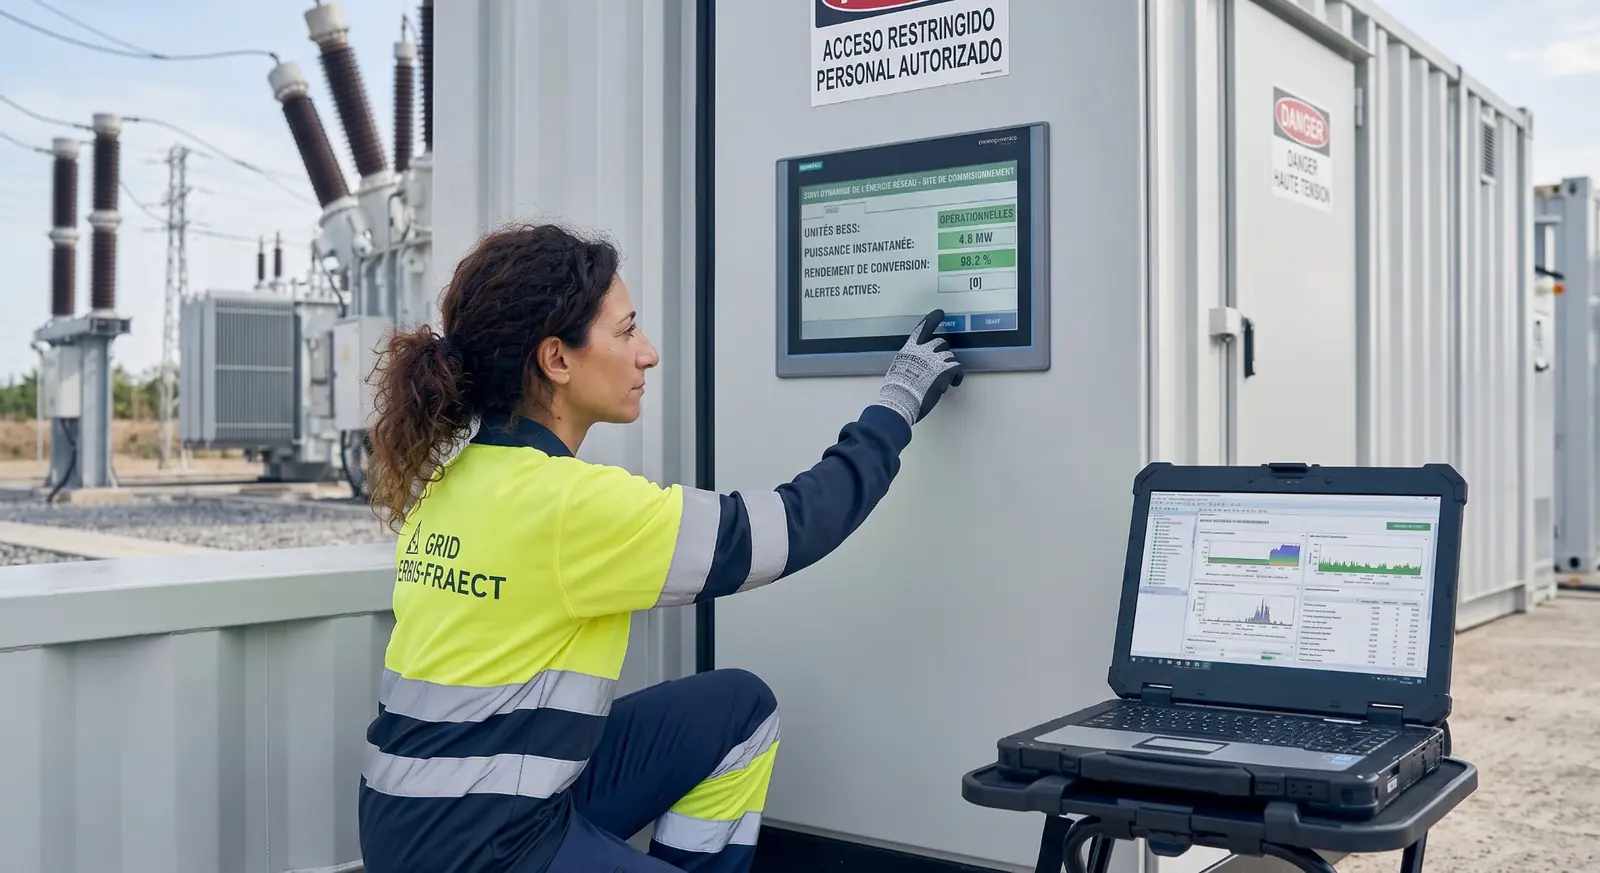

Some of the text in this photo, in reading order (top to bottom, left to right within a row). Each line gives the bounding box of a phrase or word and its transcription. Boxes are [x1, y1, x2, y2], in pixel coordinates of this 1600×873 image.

[823, 7, 995, 61] ACCESO RESTRINGIDO
[817, 38, 1002, 91] PERSONAL AUTORIZADO
[1281, 102, 1324, 140] DANGER
[804, 191, 819, 200] SUIVI
[852, 185, 860, 194] DE
[861, 181, 892, 193] L'ÉNERGIE
[893, 178, 917, 189] RÉSEAU
[922, 176, 937, 186] SITE
[938, 175, 947, 184] DE
[948, 167, 1015, 183] COMMISIONNEMENT
[1273, 168, 1299, 194] HAUTE
[939, 208, 1014, 225] OPÉRATIONNELLES
[804, 224, 860, 238] UNITÉS BESS:
[958, 232, 993, 245] 4.8 MW
[804, 237, 915, 258] PUISSANCE INSTANTANÉE:
[804, 259, 930, 278] RENDEMENT DE CONVERSION:
[960, 254, 992, 267] 98.2 %
[804, 284, 881, 299] ALERTES ACTIVES:
[969, 277, 982, 290] [0]
[425, 532, 461, 560] GRID
